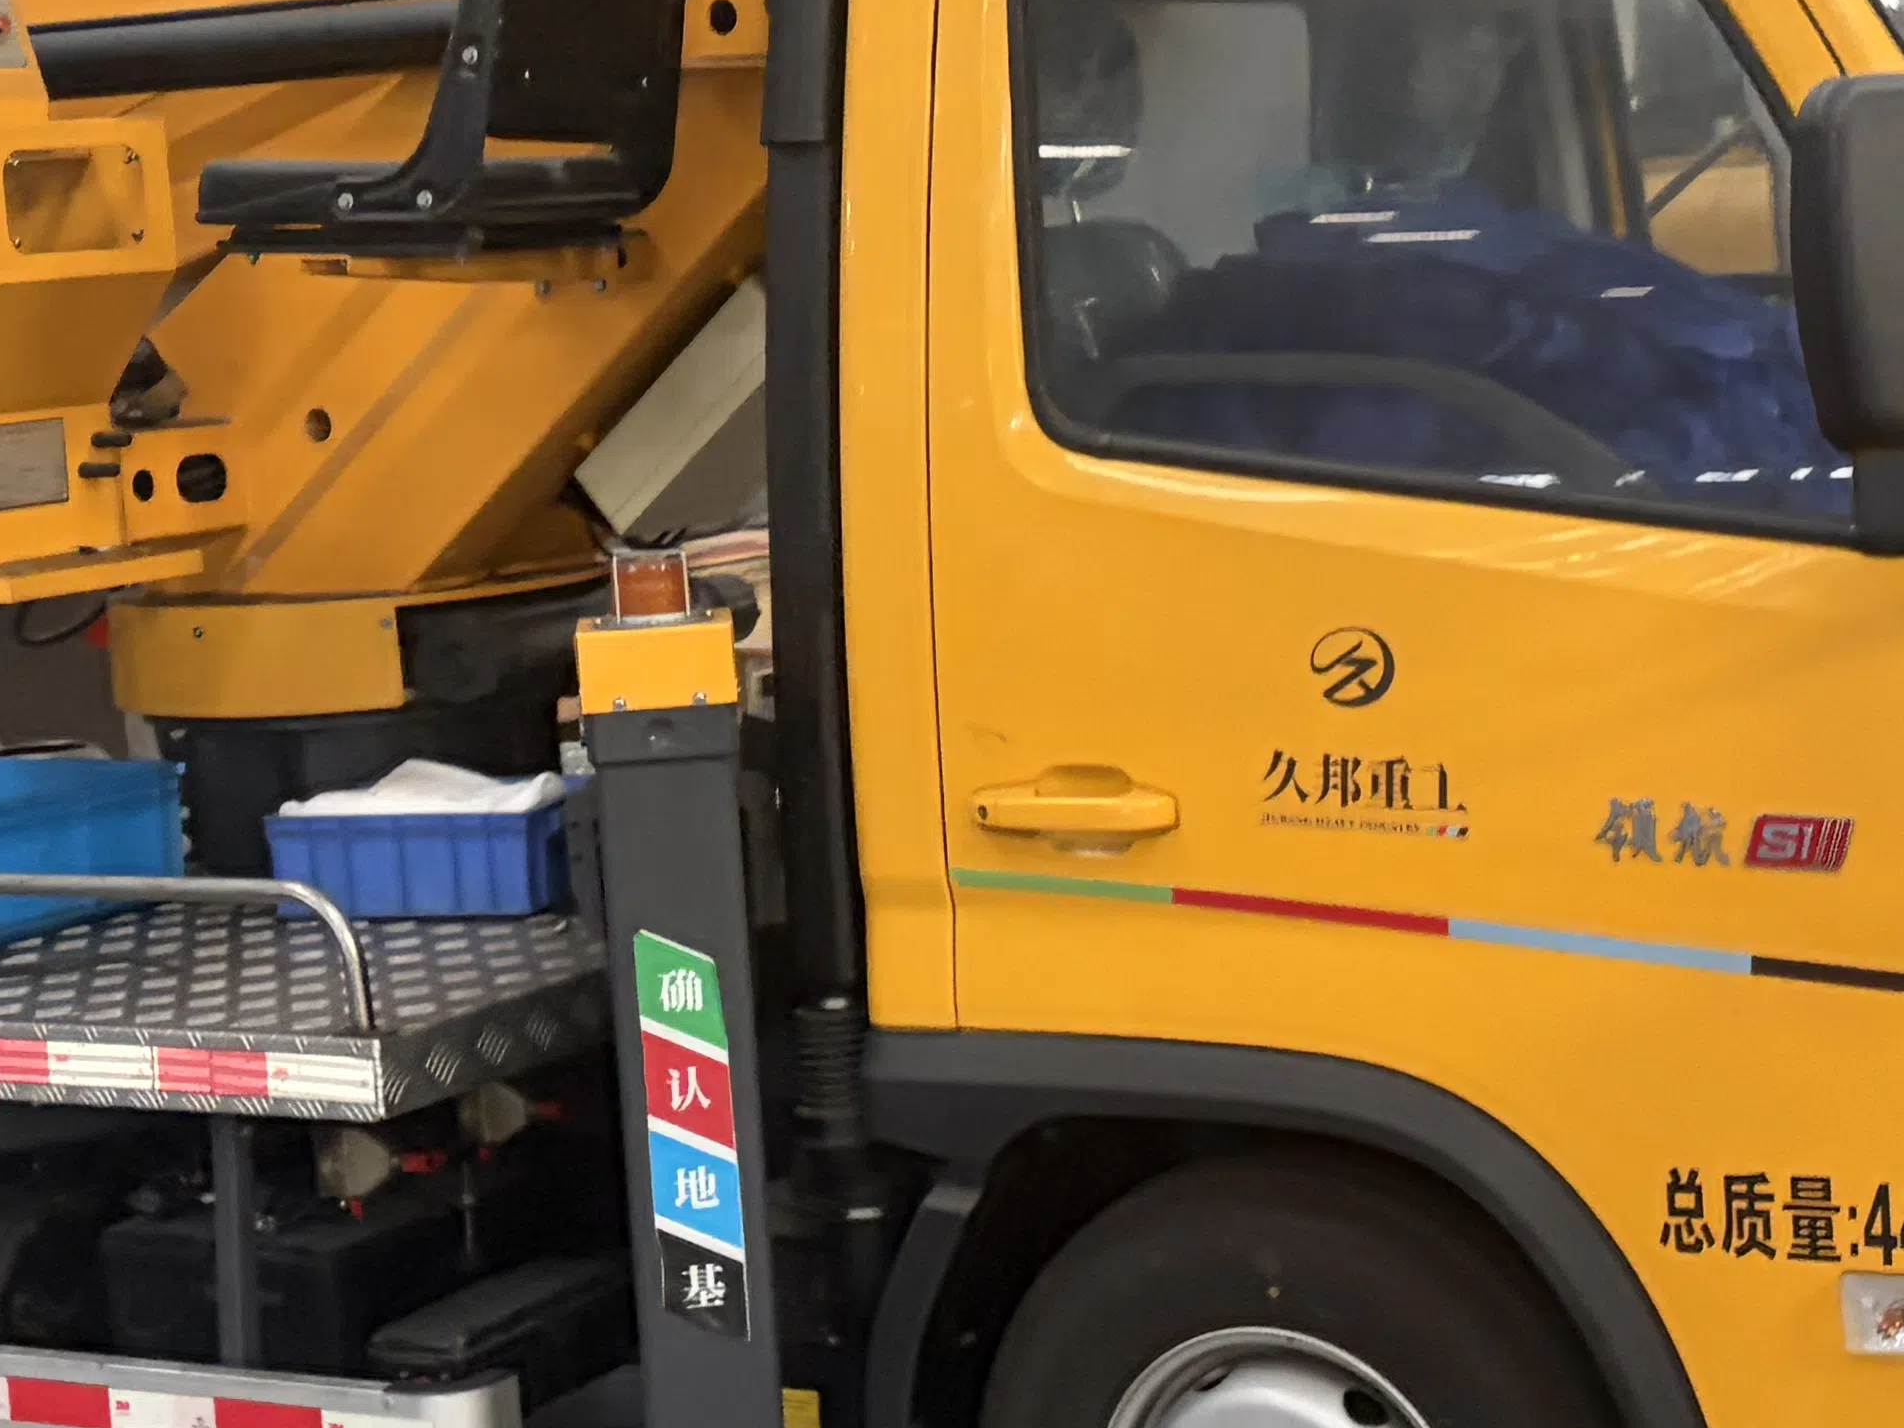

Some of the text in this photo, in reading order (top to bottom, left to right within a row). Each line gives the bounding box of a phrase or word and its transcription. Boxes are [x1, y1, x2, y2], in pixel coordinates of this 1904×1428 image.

[1254, 748, 1469, 812] 久邦重工
[659, 968, 728, 1310] 确认地基
